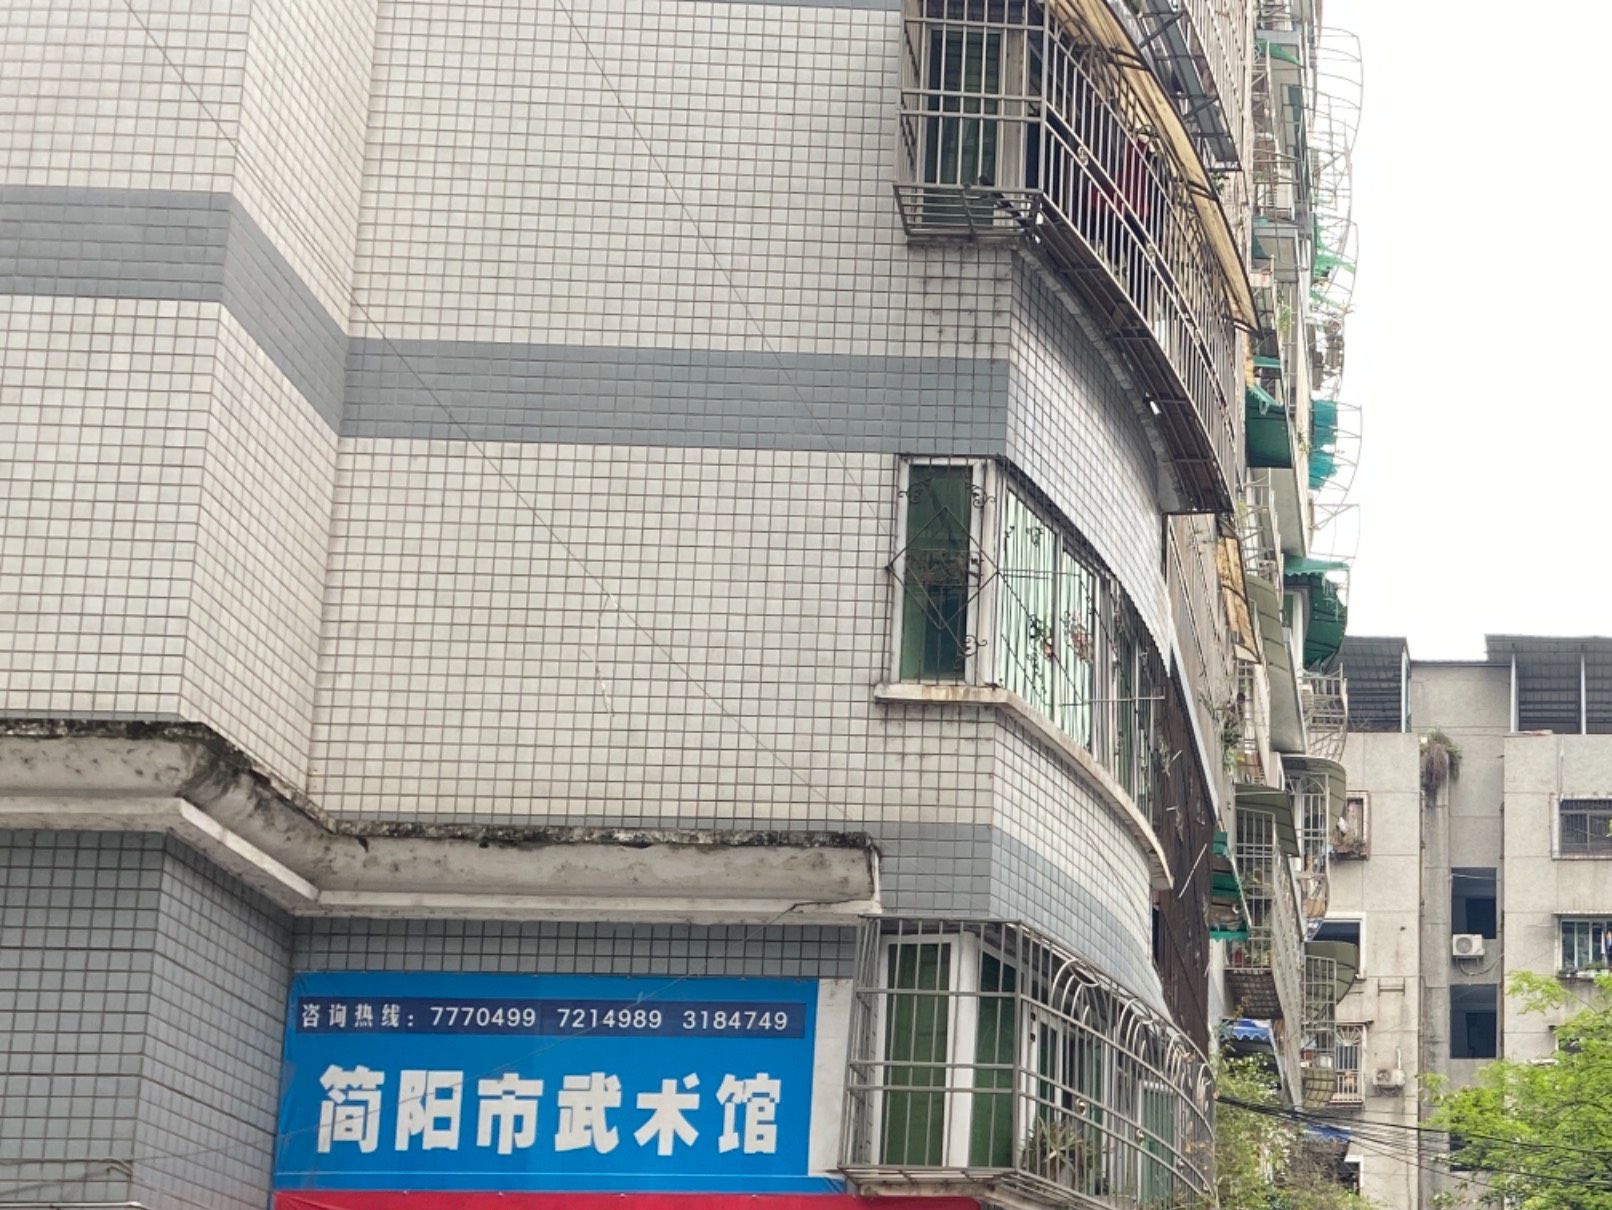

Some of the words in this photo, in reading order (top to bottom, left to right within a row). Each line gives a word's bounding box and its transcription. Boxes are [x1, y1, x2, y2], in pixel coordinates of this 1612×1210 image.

[430, 1006, 536, 1027] 7770499
[557, 1008, 662, 1029] 7214989
[682, 1011, 788, 1030] 3184749
[317, 1064, 782, 1156] 简阳市武术馆
